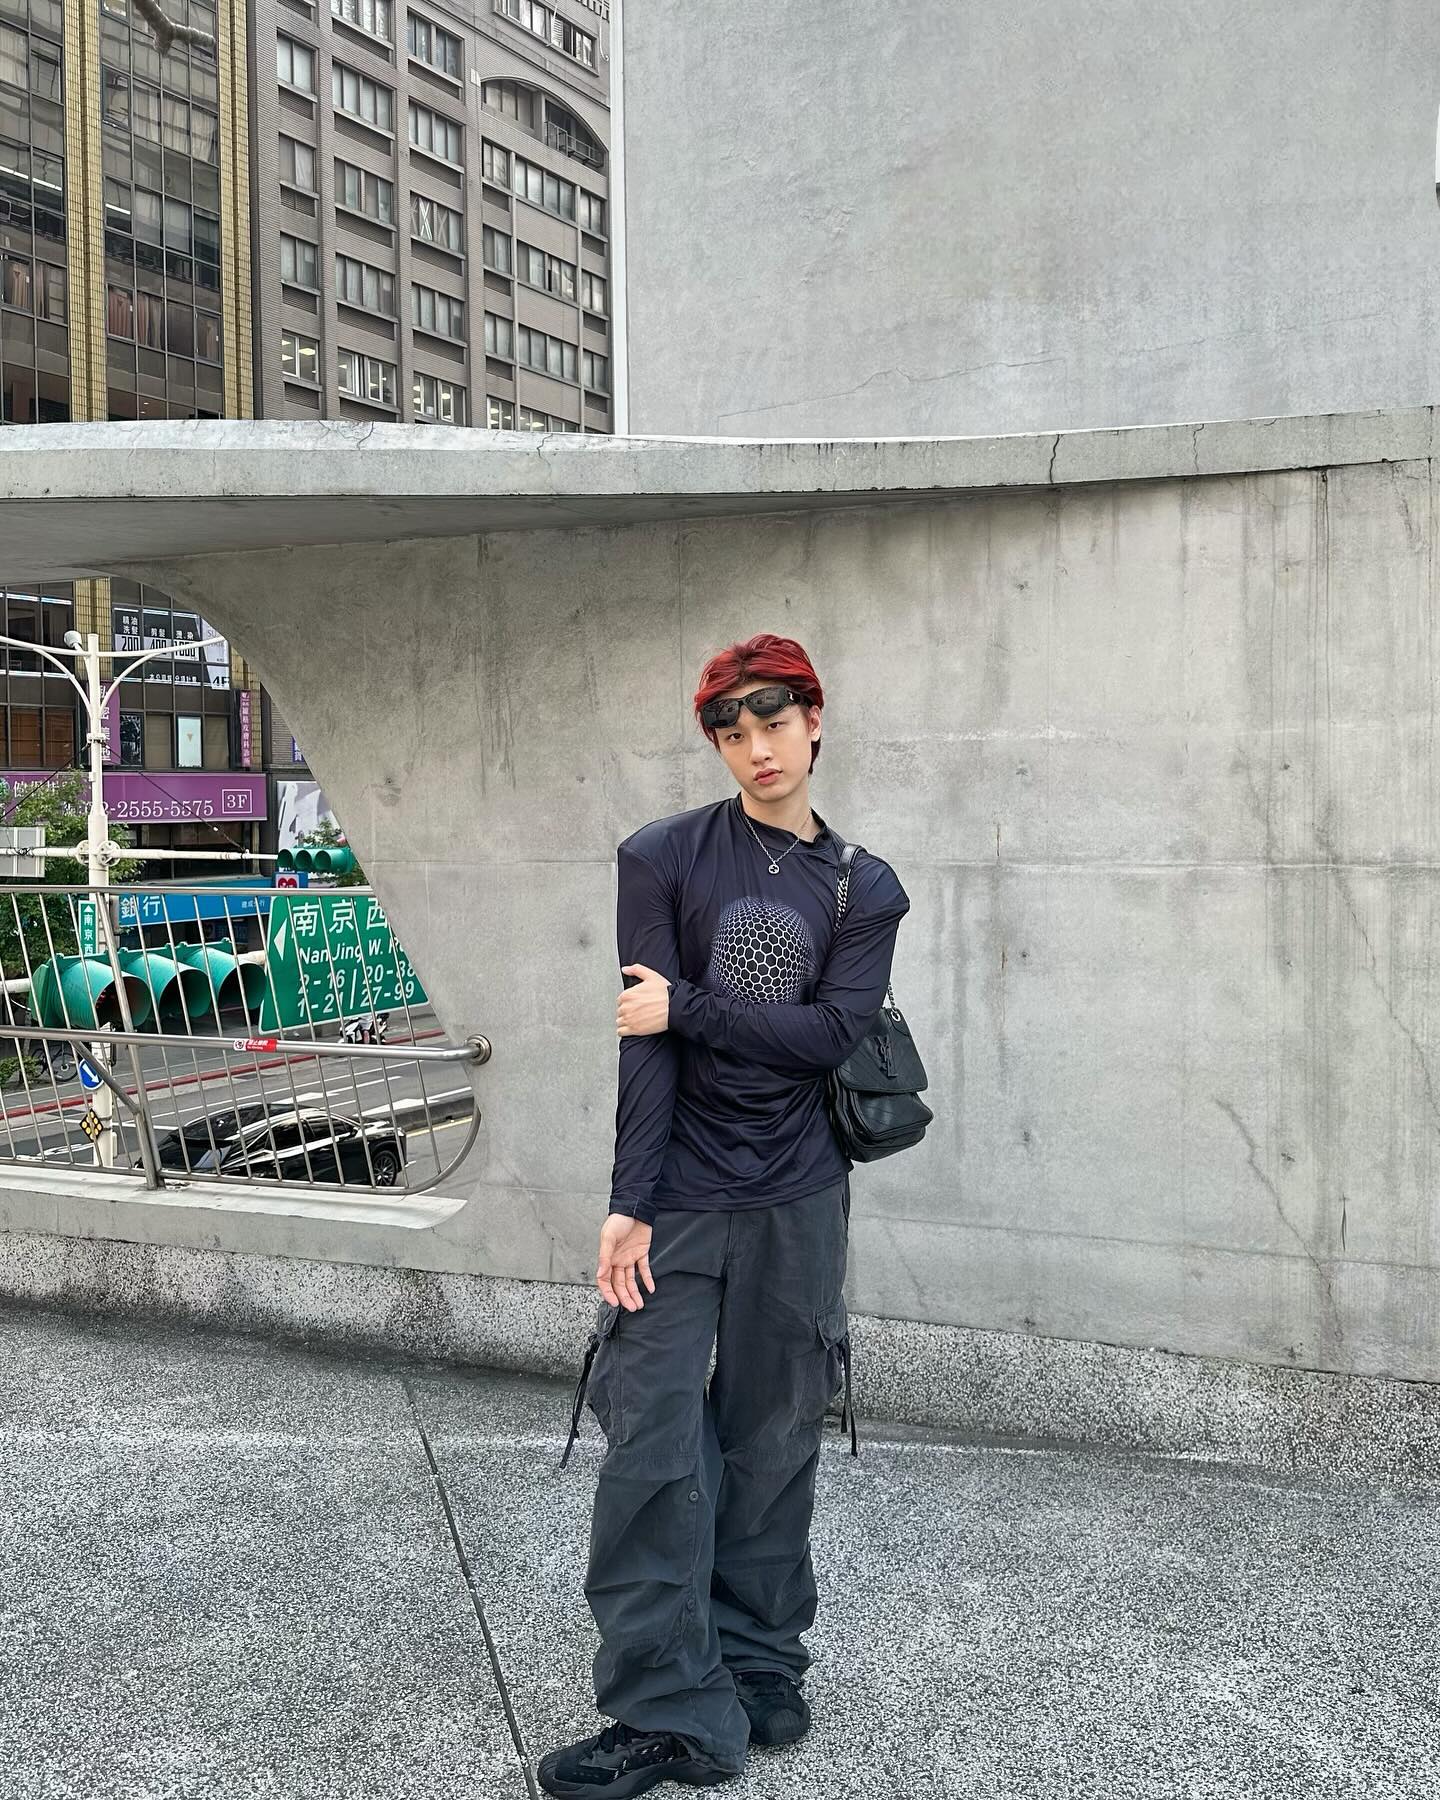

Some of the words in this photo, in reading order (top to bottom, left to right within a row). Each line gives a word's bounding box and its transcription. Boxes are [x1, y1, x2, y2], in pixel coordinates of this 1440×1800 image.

[121, 636, 139, 651] 200
[226, 794, 248, 809] 3F
[120, 895, 161, 919] 銀行
[291, 898, 389, 938] 南京西
[84, 914, 94, 954] 南京西
[368, 938, 383, 956] W.
[360, 981, 415, 1008] 27-99
